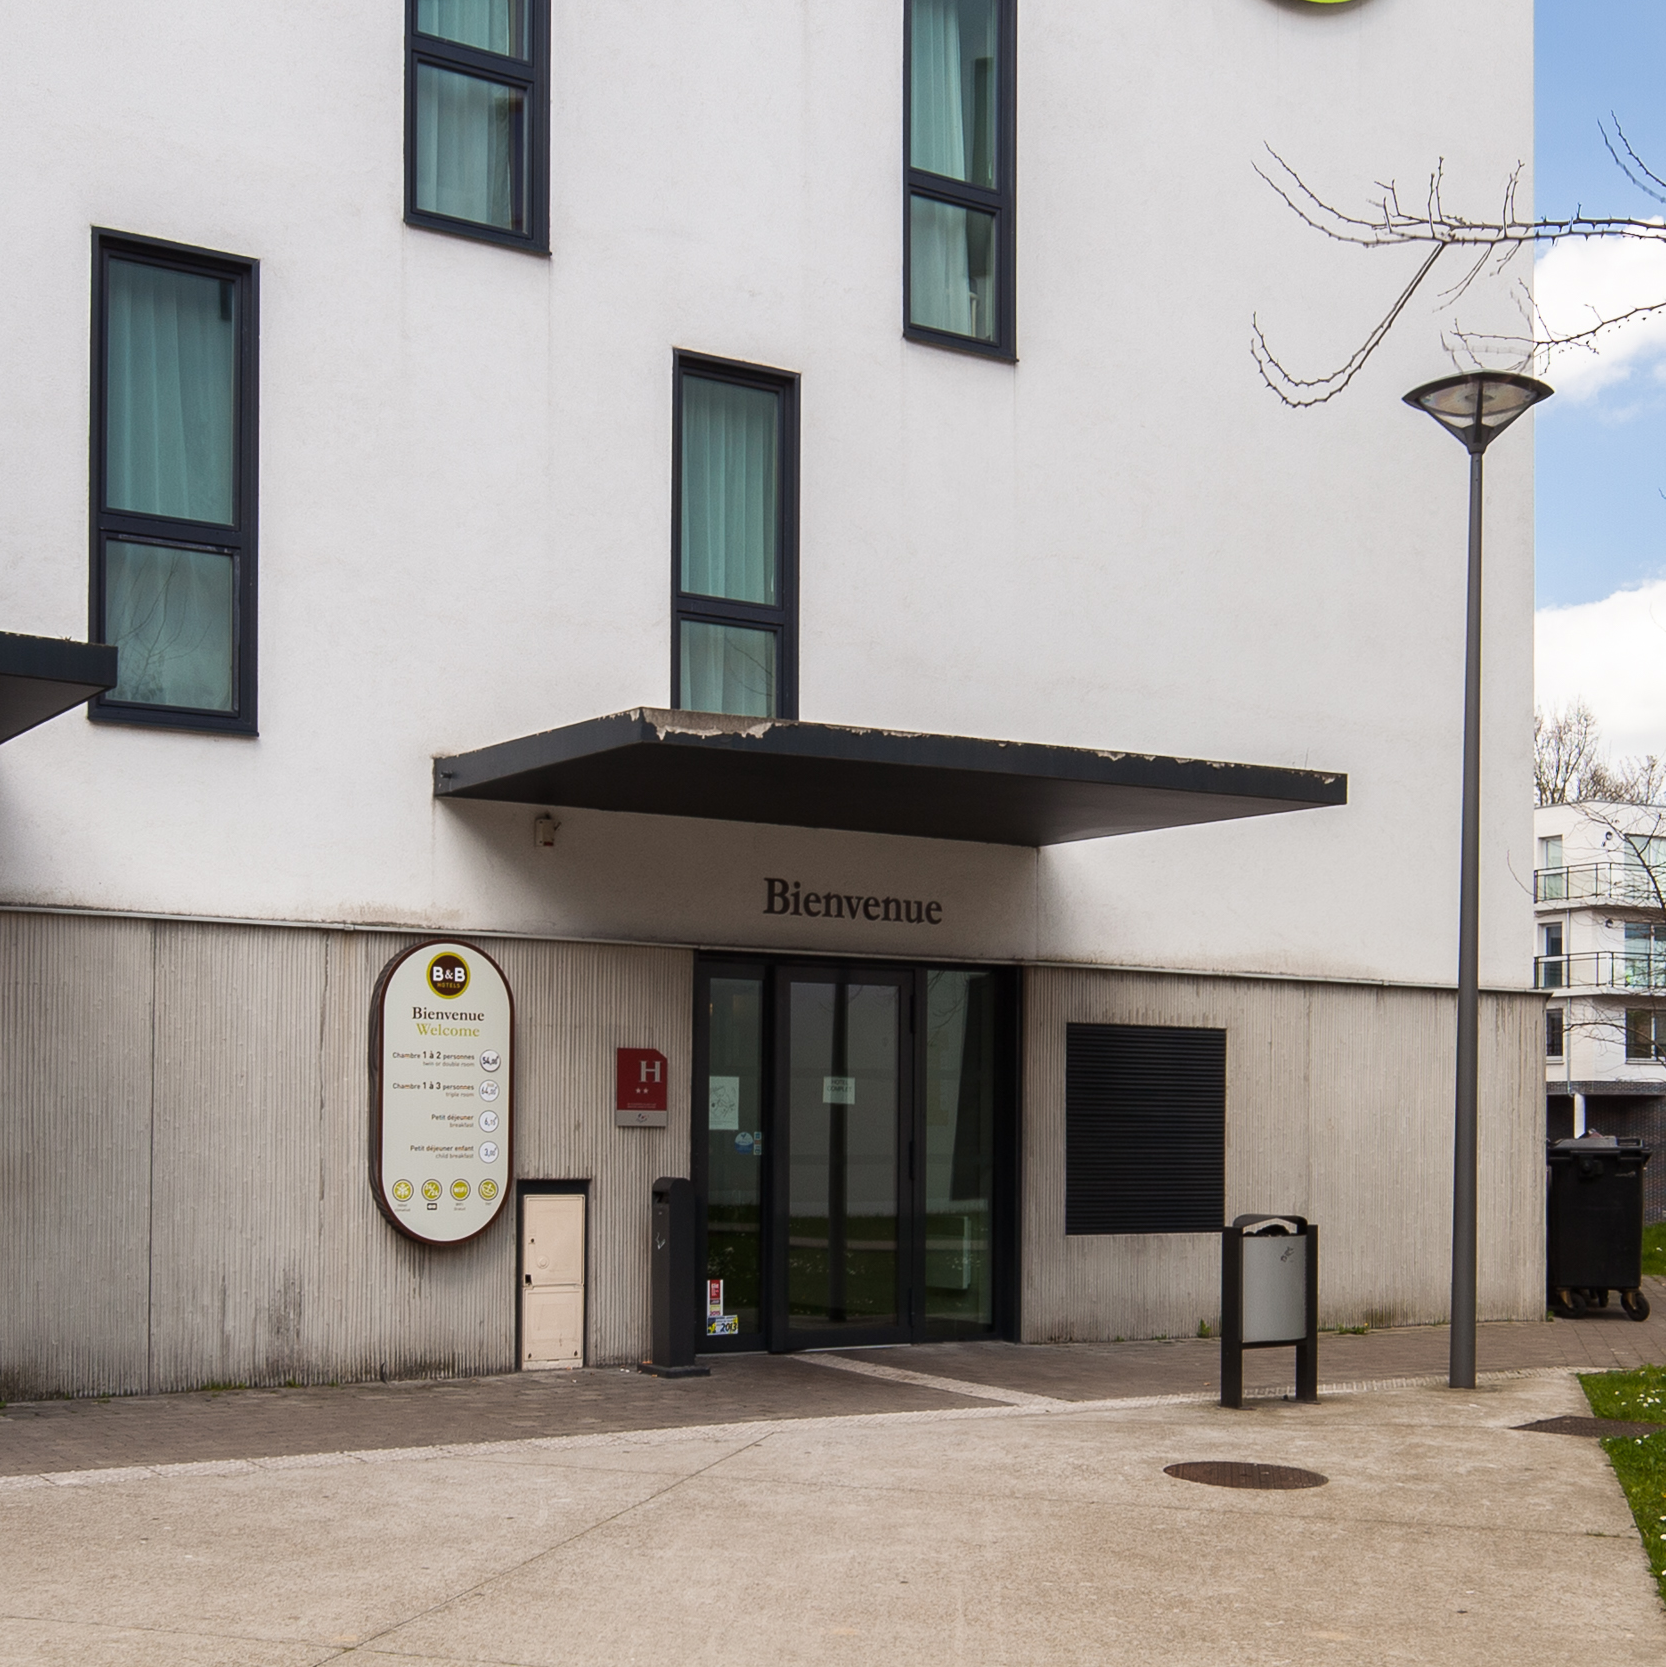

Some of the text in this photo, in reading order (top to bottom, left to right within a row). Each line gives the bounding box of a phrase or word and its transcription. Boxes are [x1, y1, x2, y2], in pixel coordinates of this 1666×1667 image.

[762, 877, 943, 925] Bienvenue
[433, 966, 466, 982] B&B
[412, 1006, 485, 1021] Bienvenue
[416, 1023, 480, 1037] Welcome
[392, 1050, 475, 1061] Chambre 1 à 2 personnes
[639, 1060, 663, 1083] H
[423, 1081, 427, 1089] 1
[429, 1081, 434, 1089] à
[447, 1114, 474, 1122] déjeuner
[426, 1145, 454, 1153] déjeuner
